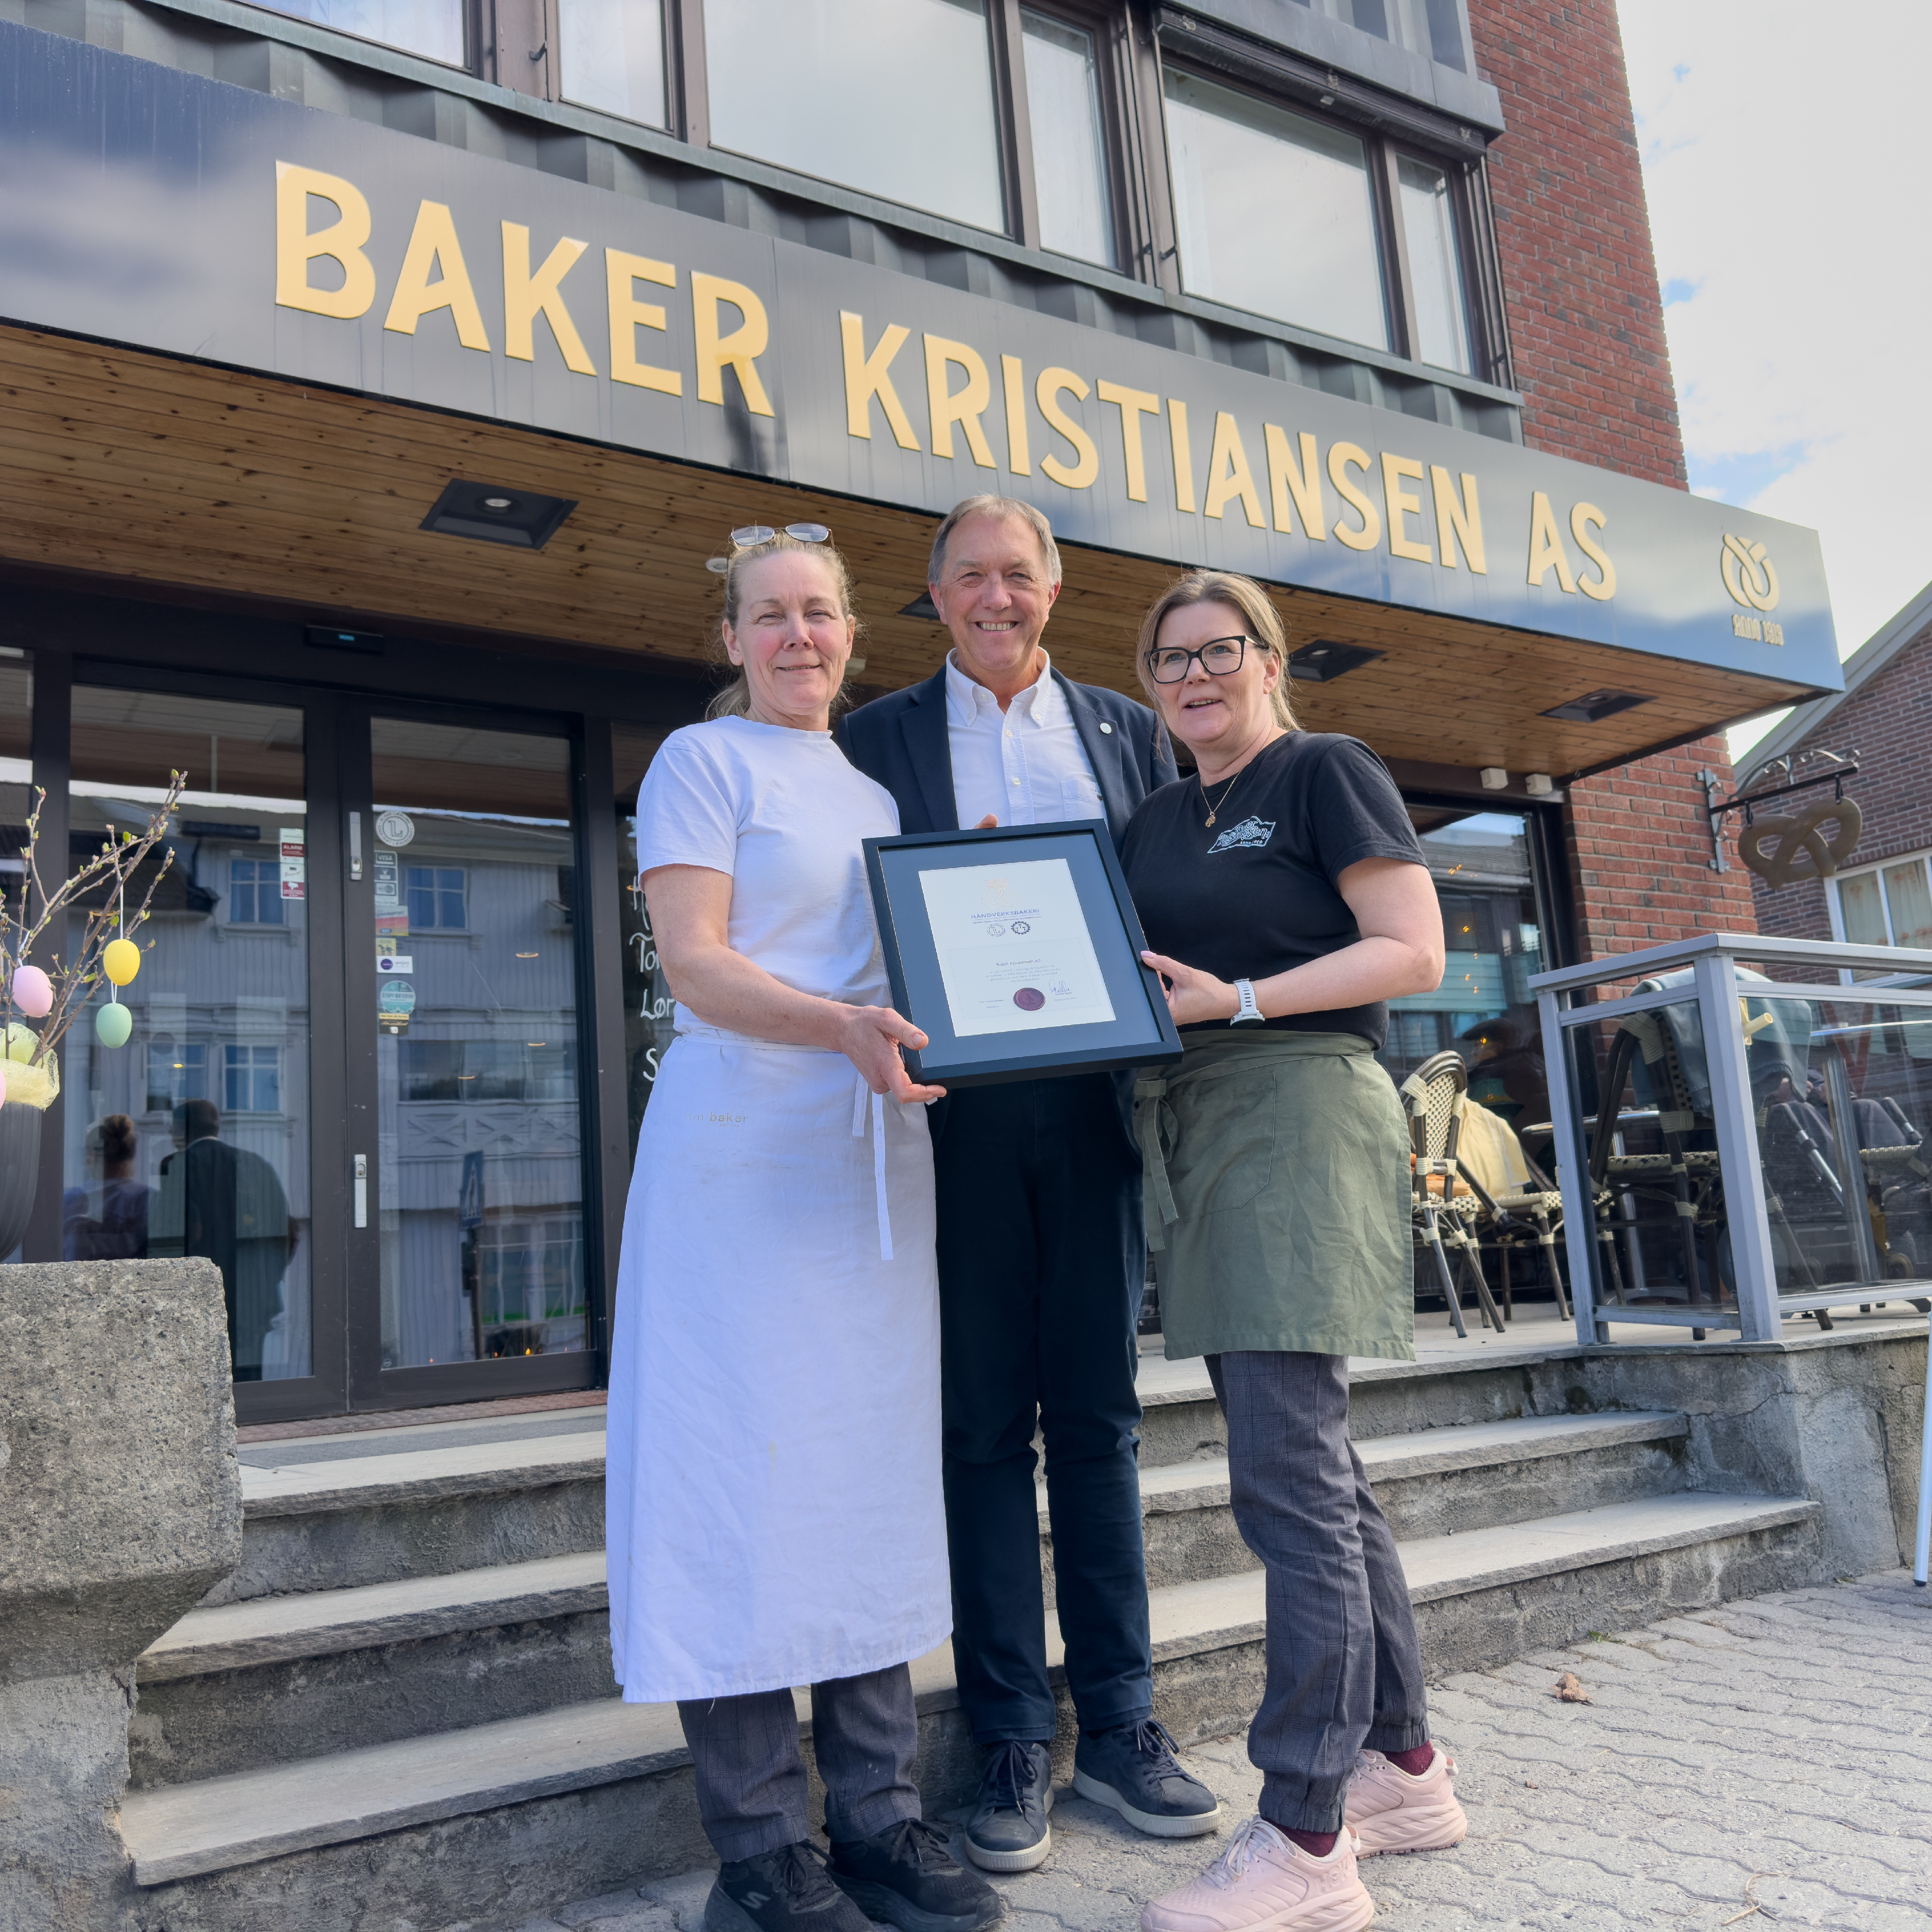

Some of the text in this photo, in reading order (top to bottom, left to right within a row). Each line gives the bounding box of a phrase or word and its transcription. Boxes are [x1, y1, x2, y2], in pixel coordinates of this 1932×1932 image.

[275, 159, 1617, 601] BAKER KRISTIANSEN AS
[971, 909, 1040, 919] HÅNDVERKSBAKERI
[685, 1111, 749, 1123] din baker
